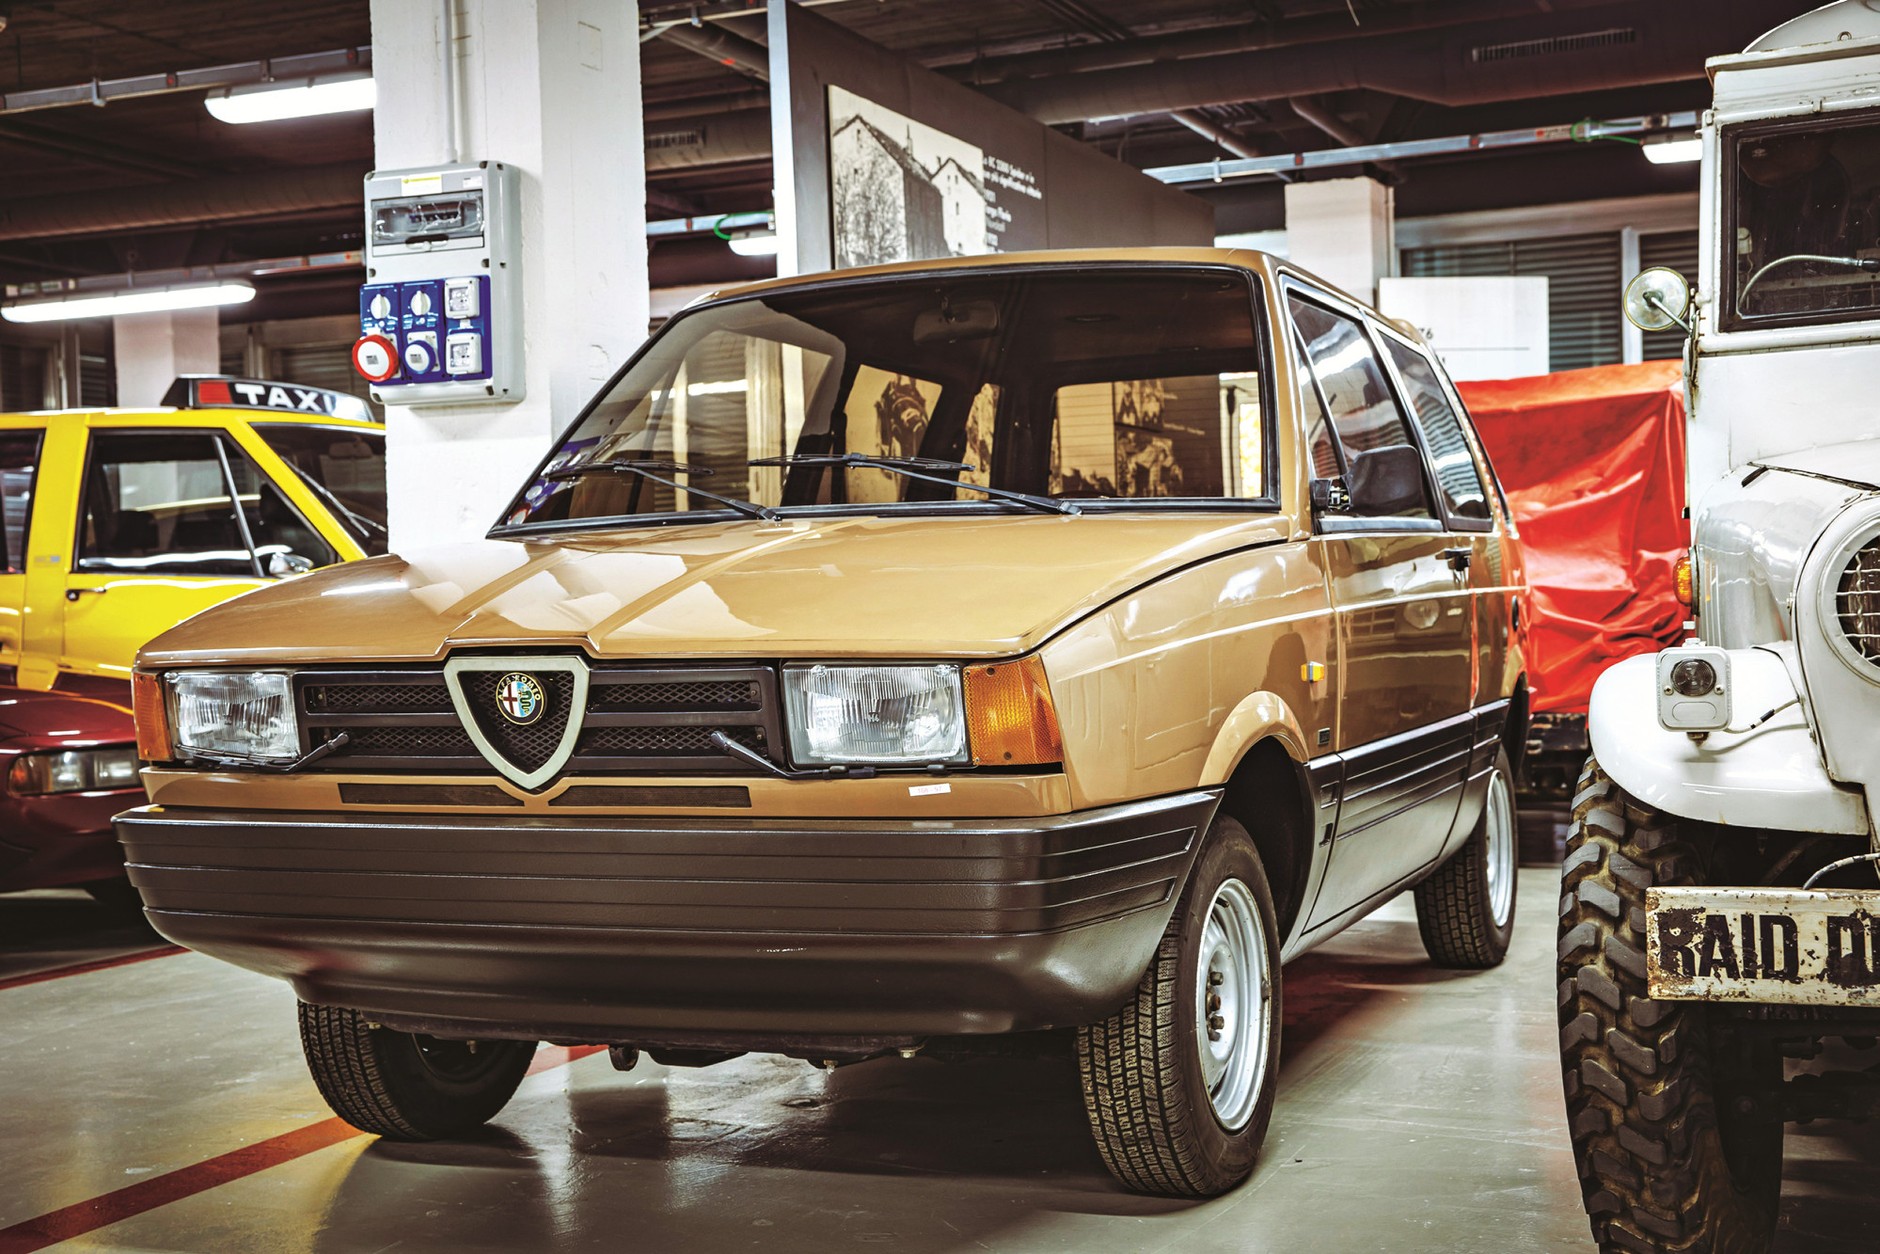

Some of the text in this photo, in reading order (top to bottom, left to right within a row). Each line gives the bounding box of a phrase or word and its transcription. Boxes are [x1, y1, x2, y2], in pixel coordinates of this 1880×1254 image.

[234, 383, 334, 413] TAXI
[514, 675, 541, 701] ROMEO
[1658, 911, 1799, 980] RAID
